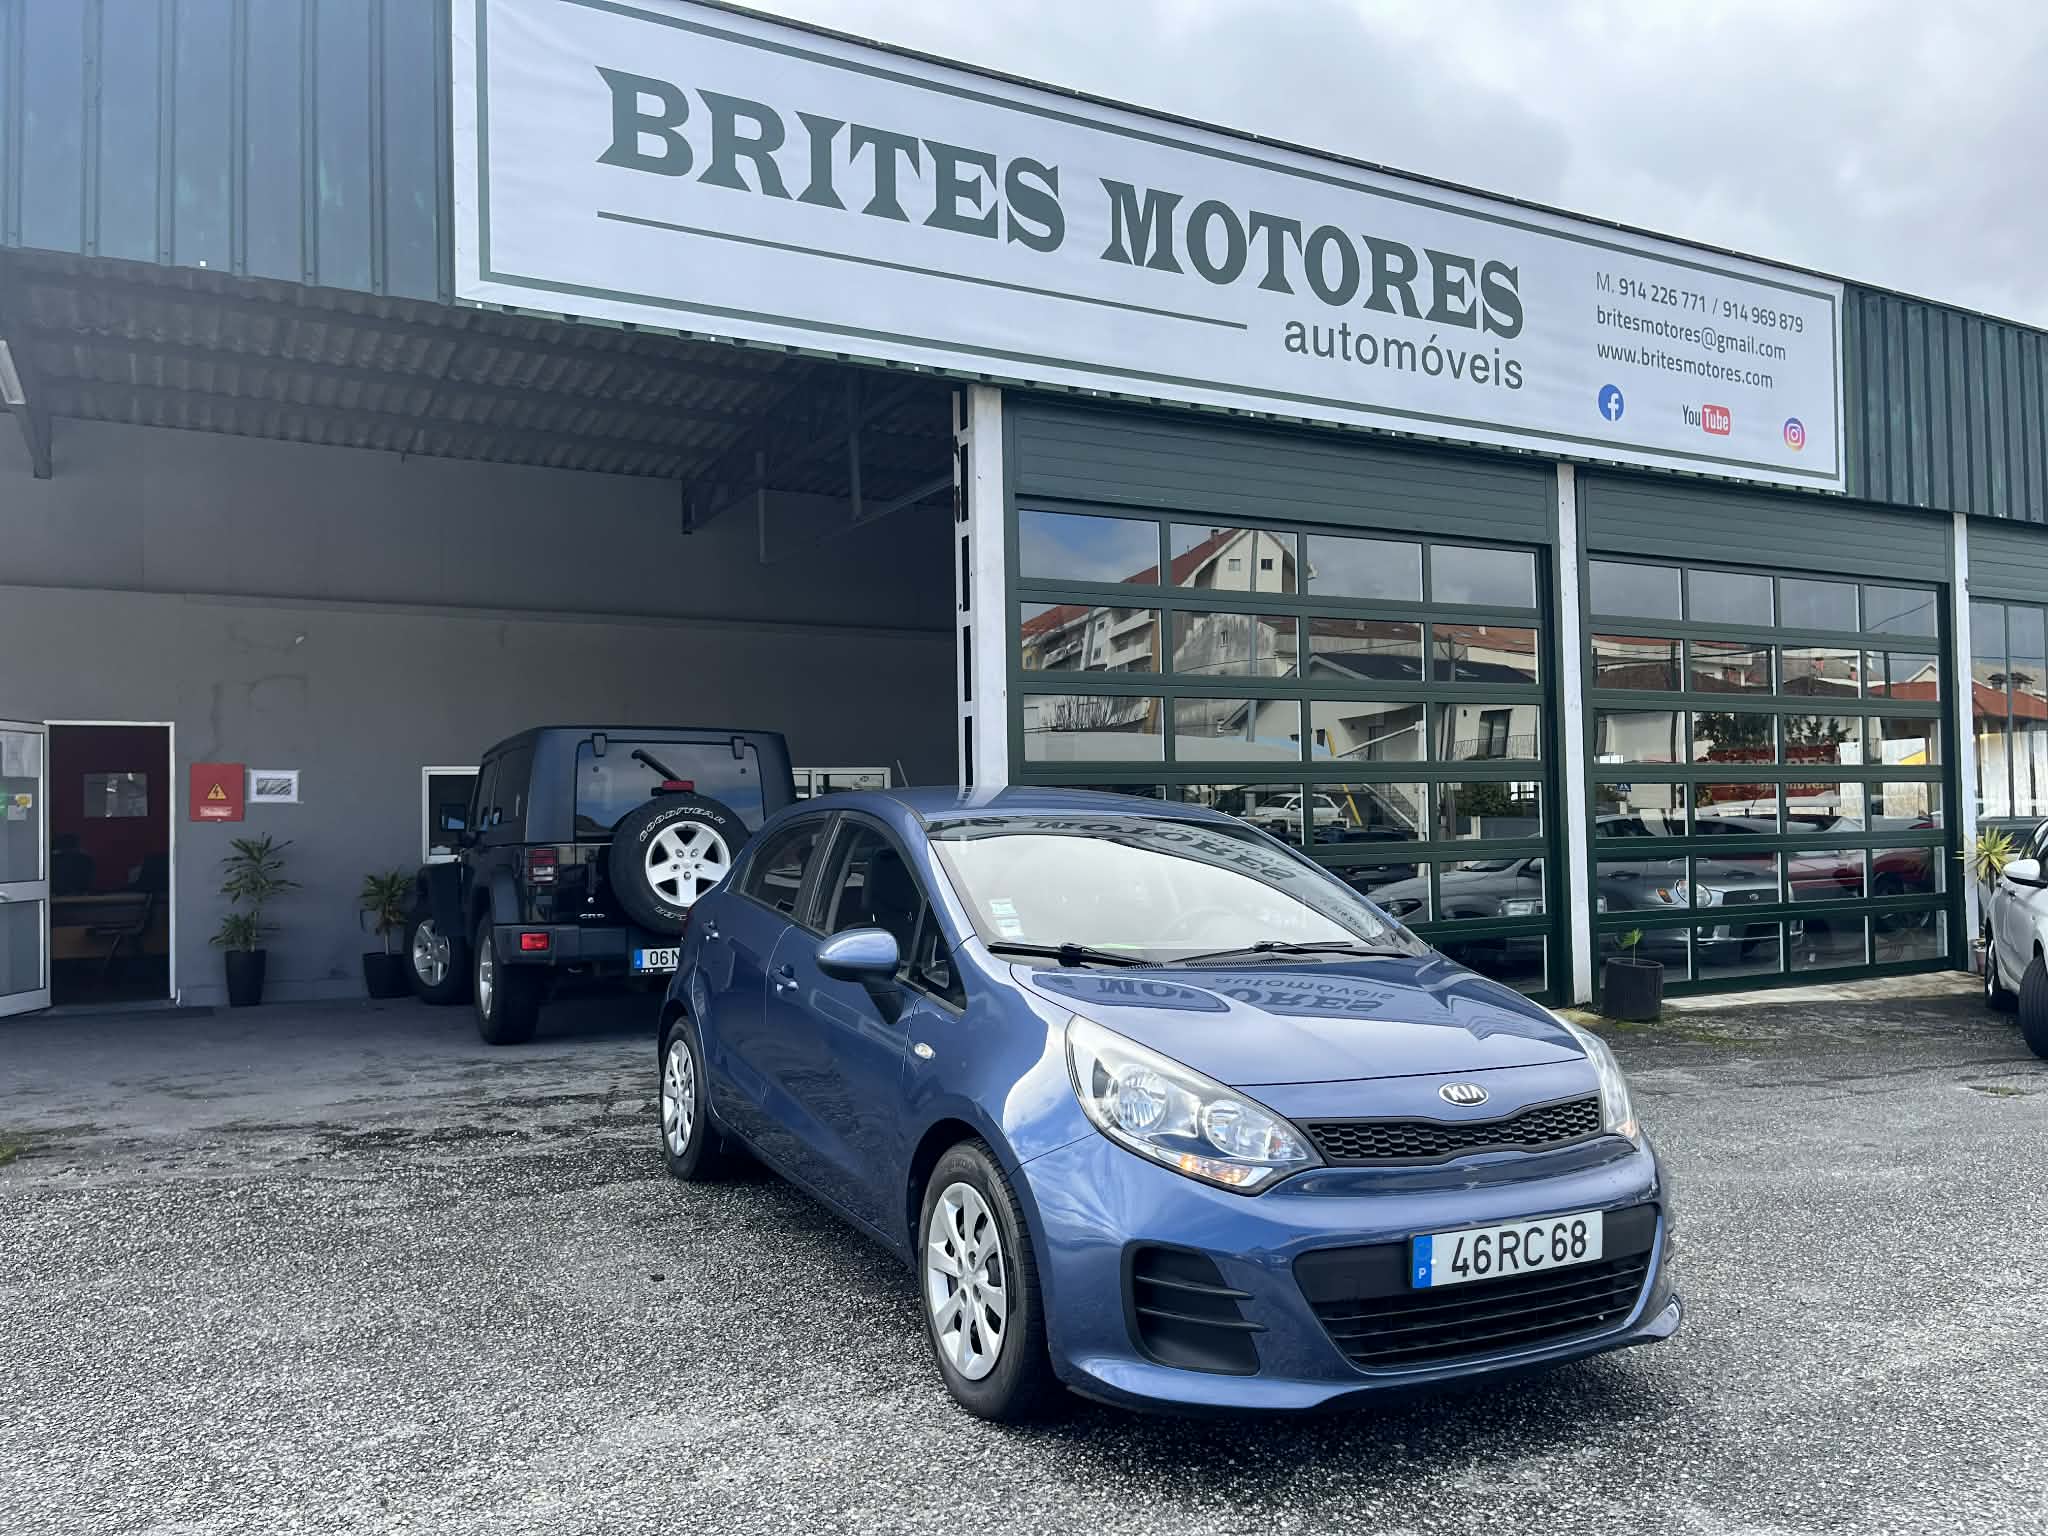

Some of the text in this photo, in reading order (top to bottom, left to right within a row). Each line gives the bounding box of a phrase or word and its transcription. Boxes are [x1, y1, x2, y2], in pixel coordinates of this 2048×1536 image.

[594, 65, 1524, 339] BRITES MOTORES
[1596, 272, 1804, 333] M. 914 226 771 / 914 969 879
[1284, 320, 1524, 390] automóveis
[1597, 306, 1786, 361] britesmotores@gmail.com
[1597, 343, 1774, 389] www.britesmotores.com
[639, 806, 727, 842] GOODYEAR
[1445, 1084, 1484, 1101] KIA
[1418, 1268, 1426, 1279] P
